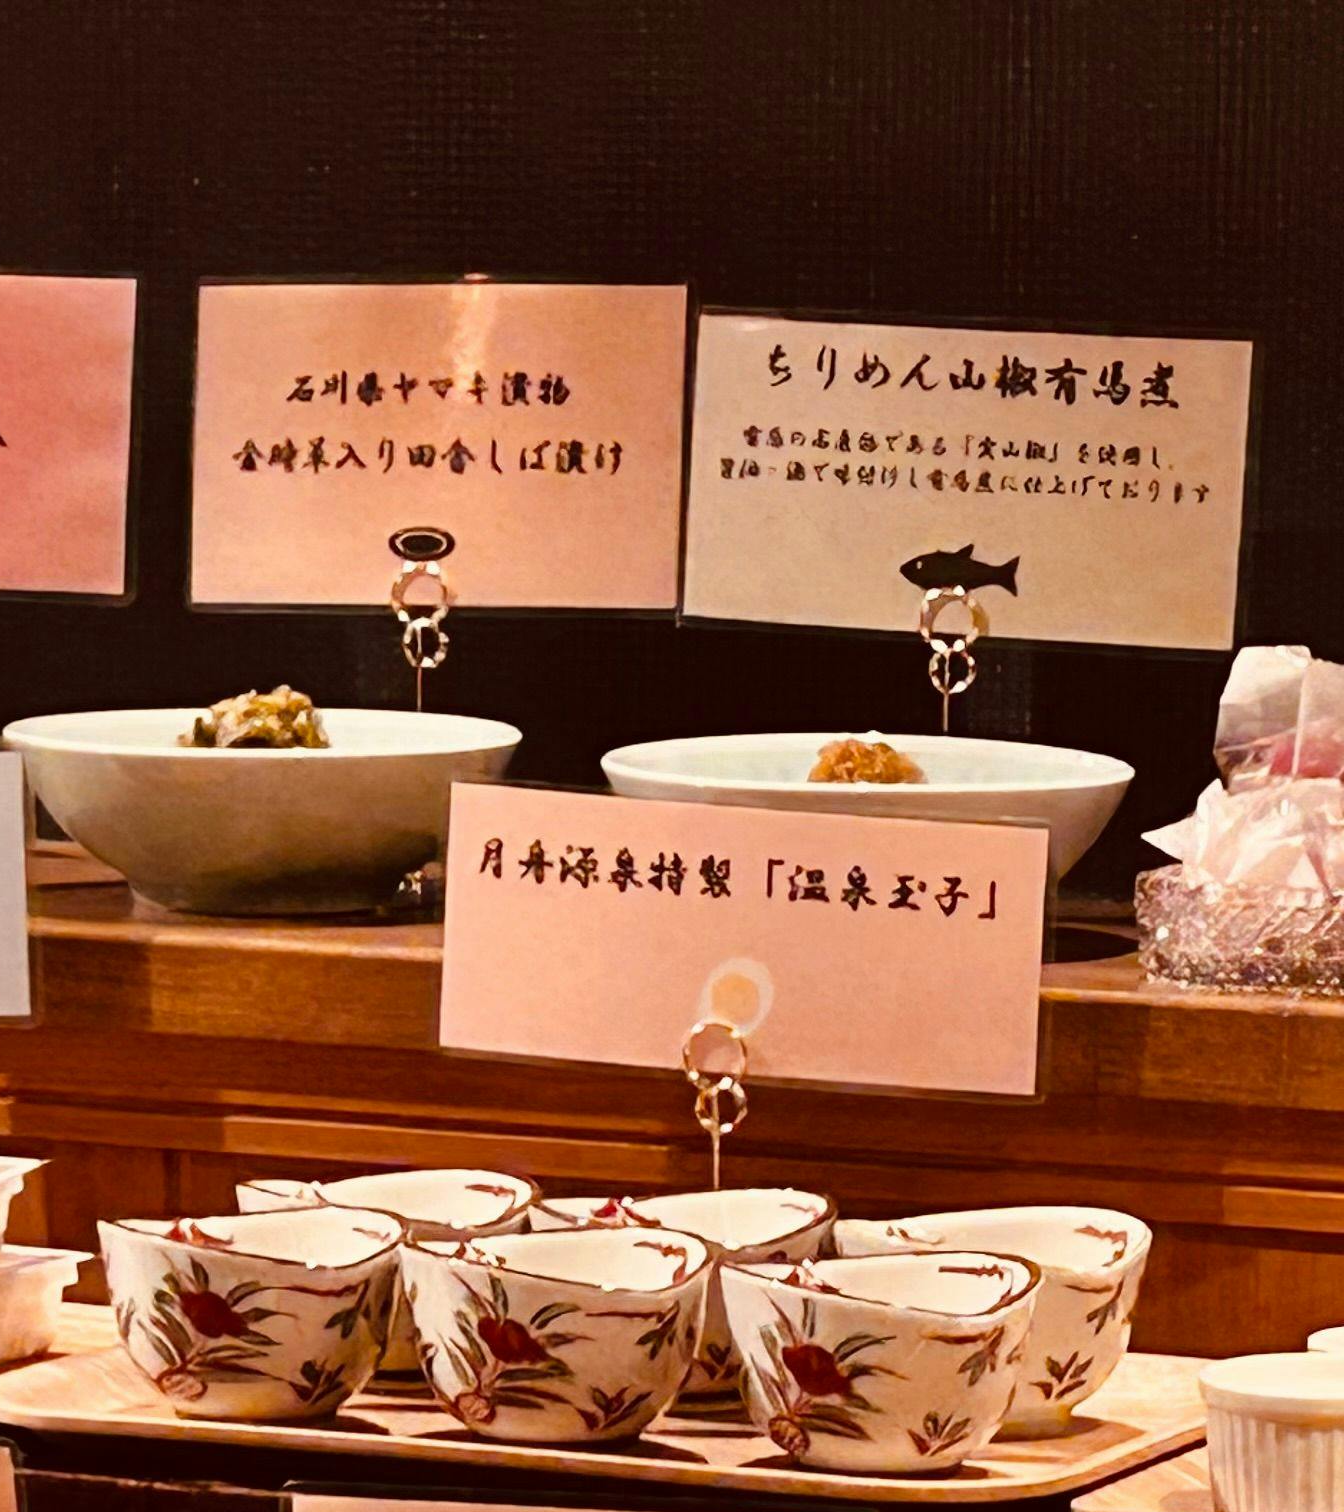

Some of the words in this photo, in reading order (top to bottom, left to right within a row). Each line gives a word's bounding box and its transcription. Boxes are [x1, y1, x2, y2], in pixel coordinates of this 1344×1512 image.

[768, 343, 1180, 410] ちりめん山椒有馬煮
